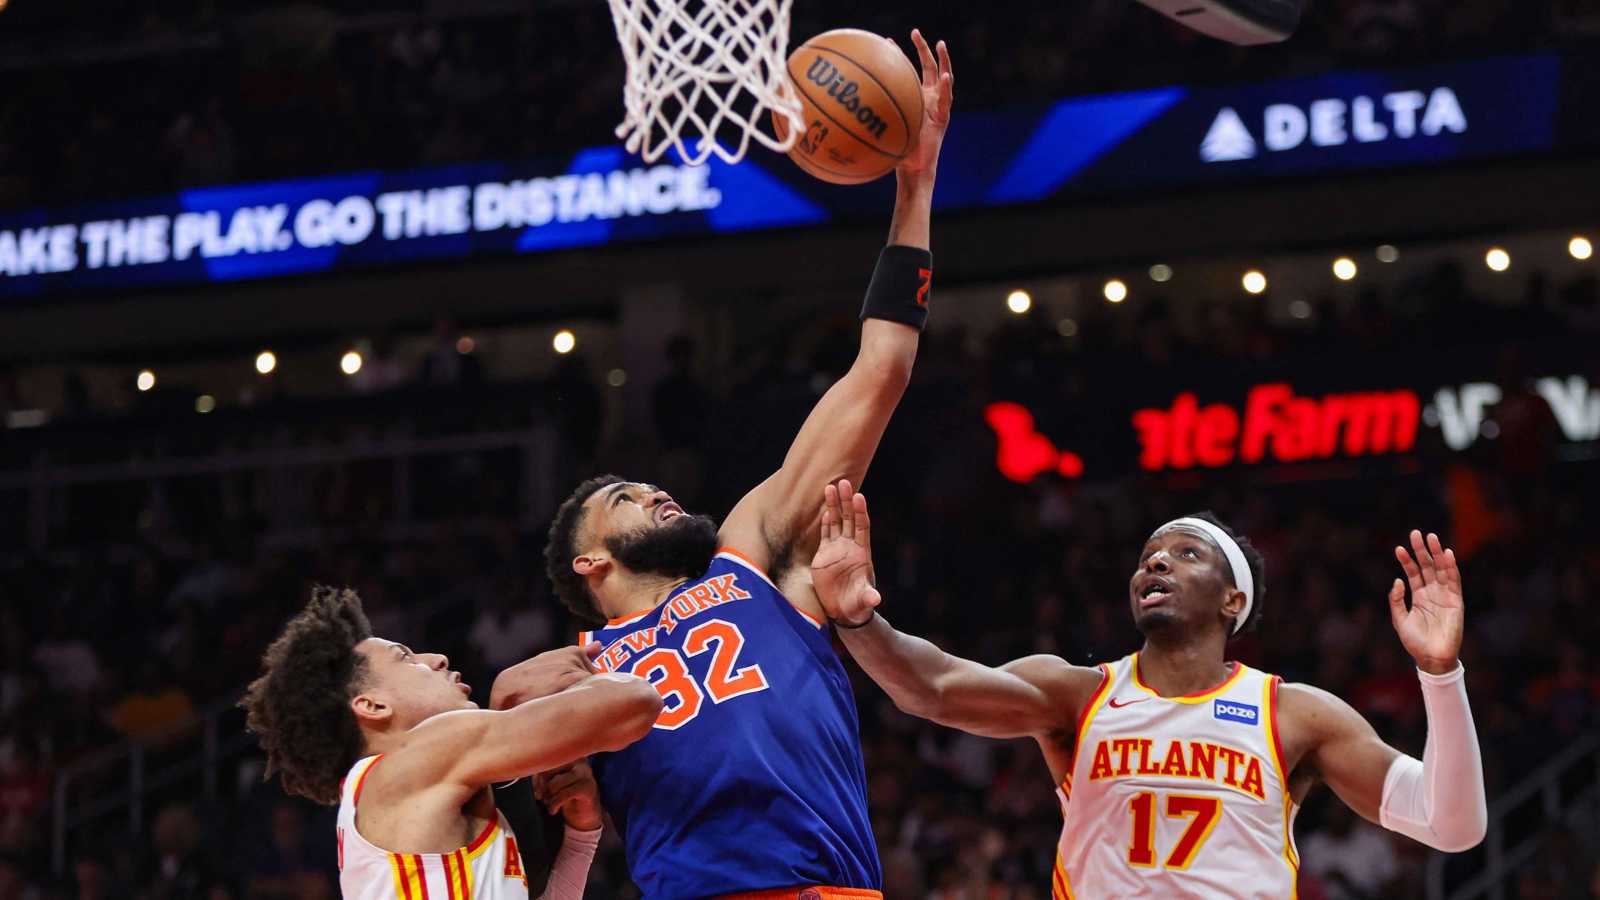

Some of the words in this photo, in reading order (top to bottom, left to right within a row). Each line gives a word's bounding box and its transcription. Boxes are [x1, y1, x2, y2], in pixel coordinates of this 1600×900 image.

[806, 55, 888, 140] Wilson
[1263, 86, 1467, 152] DELTA
[80, 215, 171, 269] THE
[173, 203, 293, 261] PLAY.
[294, 195, 375, 249] GO
[376, 186, 472, 241] THE
[473, 163, 722, 232] DISTANCE.
[1240, 382, 1419, 464] Farm
[658, 572, 752, 635] YORK
[631, 618, 769, 731] 32
[1215, 702, 1257, 721] paze
[1089, 737, 1266, 801] ATLANTA
[1128, 790, 1224, 870] 17
